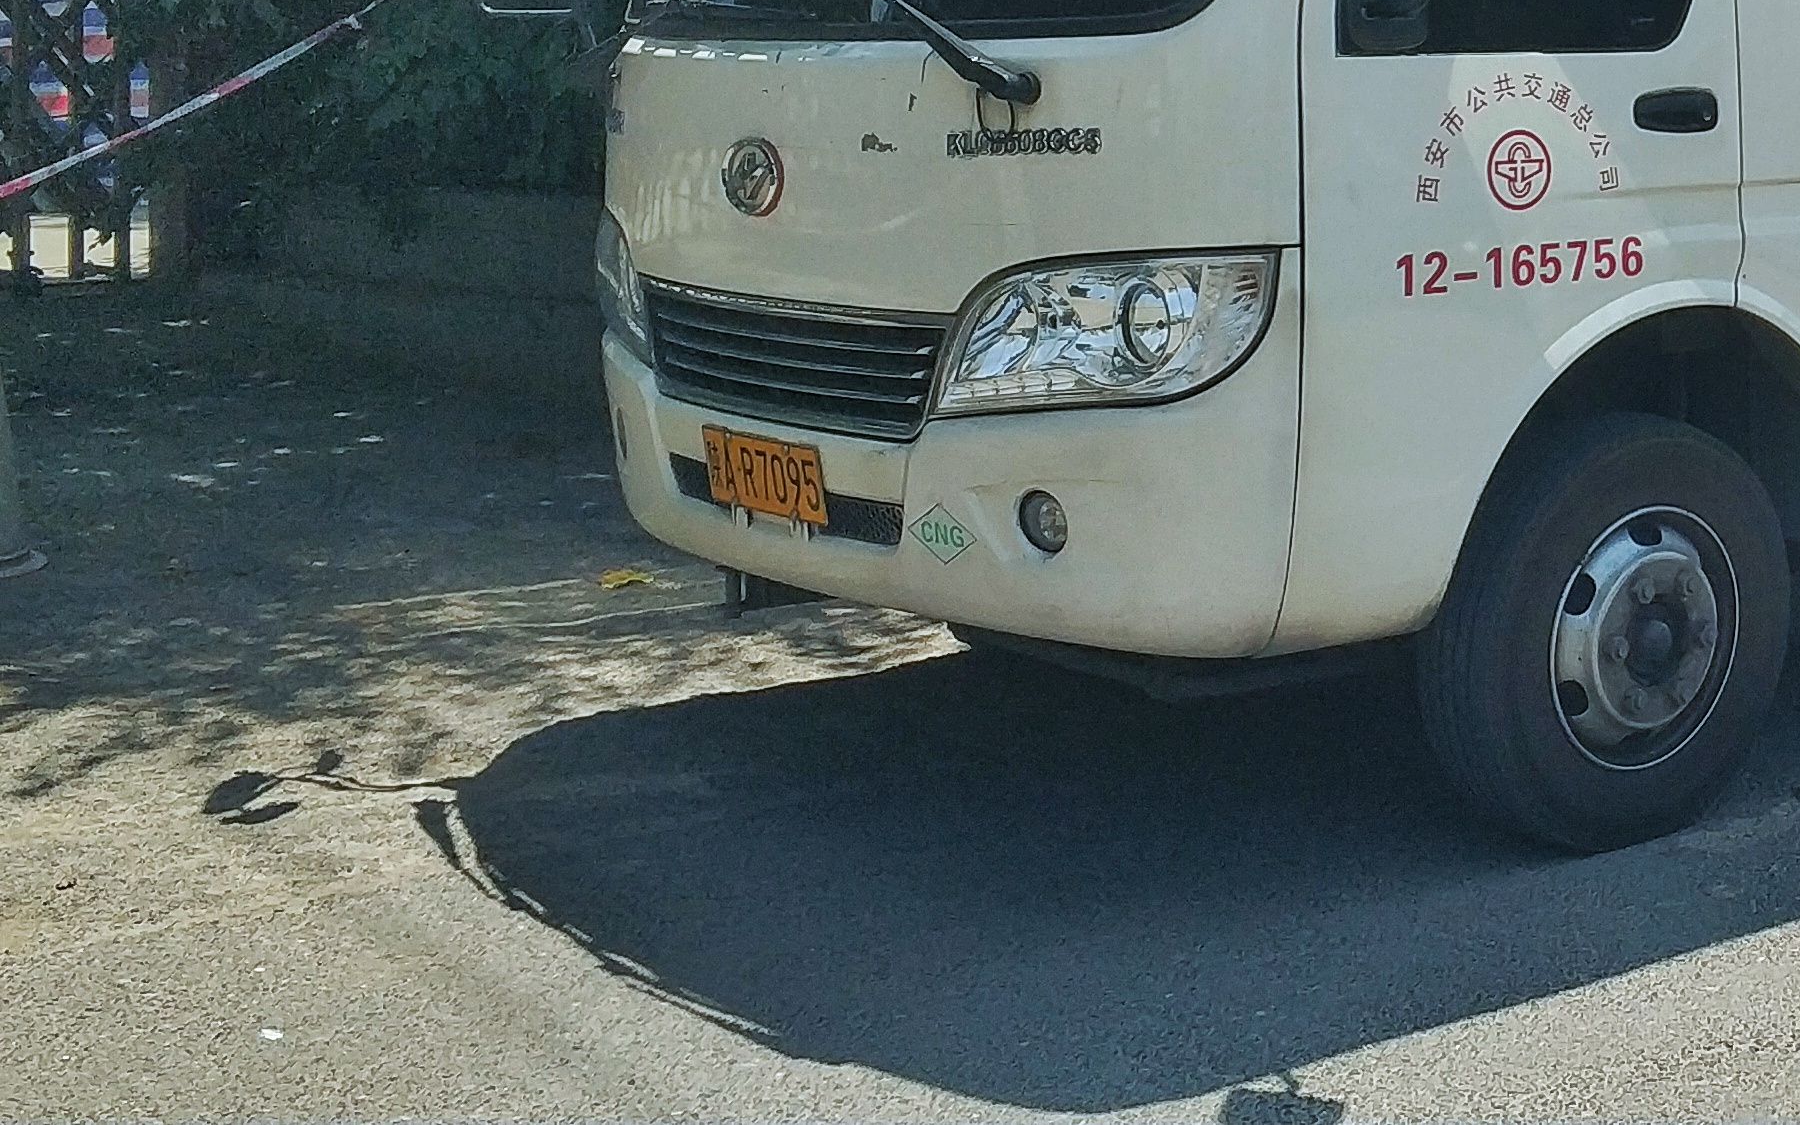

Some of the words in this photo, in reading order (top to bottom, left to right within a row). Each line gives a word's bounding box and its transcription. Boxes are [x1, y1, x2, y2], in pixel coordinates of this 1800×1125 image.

[1416, 73, 1619, 203] 西安市公共交通总公司
[1396, 236, 1643, 297] 12-165756
[921, 521, 965, 548] CNG
